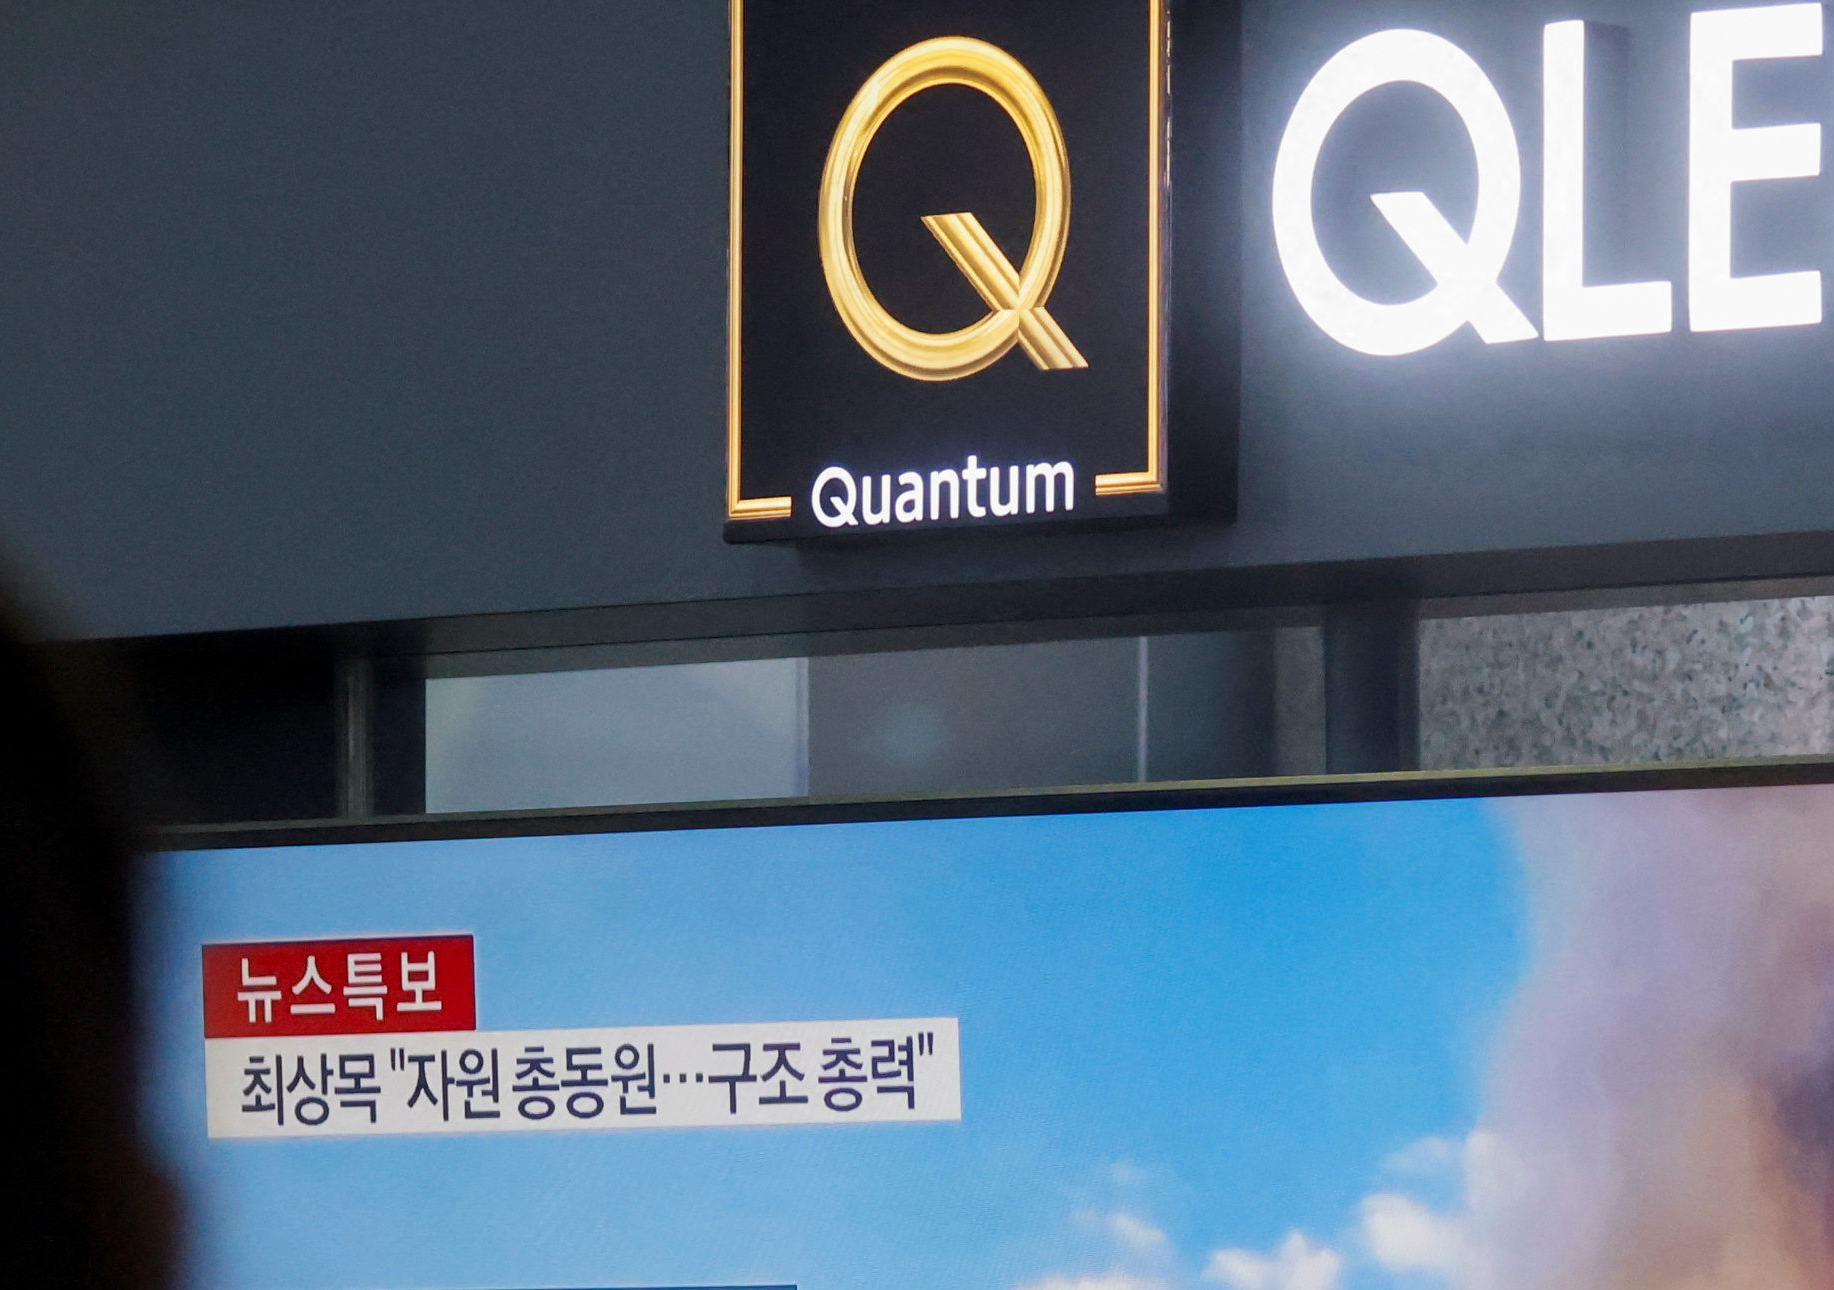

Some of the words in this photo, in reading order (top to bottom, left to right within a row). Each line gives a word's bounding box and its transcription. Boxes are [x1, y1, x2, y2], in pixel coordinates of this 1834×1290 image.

[818, 36, 1087, 381] Q
[811, 455, 1074, 528] Quantum
[237, 952, 443, 1023] 뉴스특보
[241, 1049, 378, 1126] 최상목
[391, 1047, 499, 1121] "자원
[816, 1032, 935, 1111] 총력"
